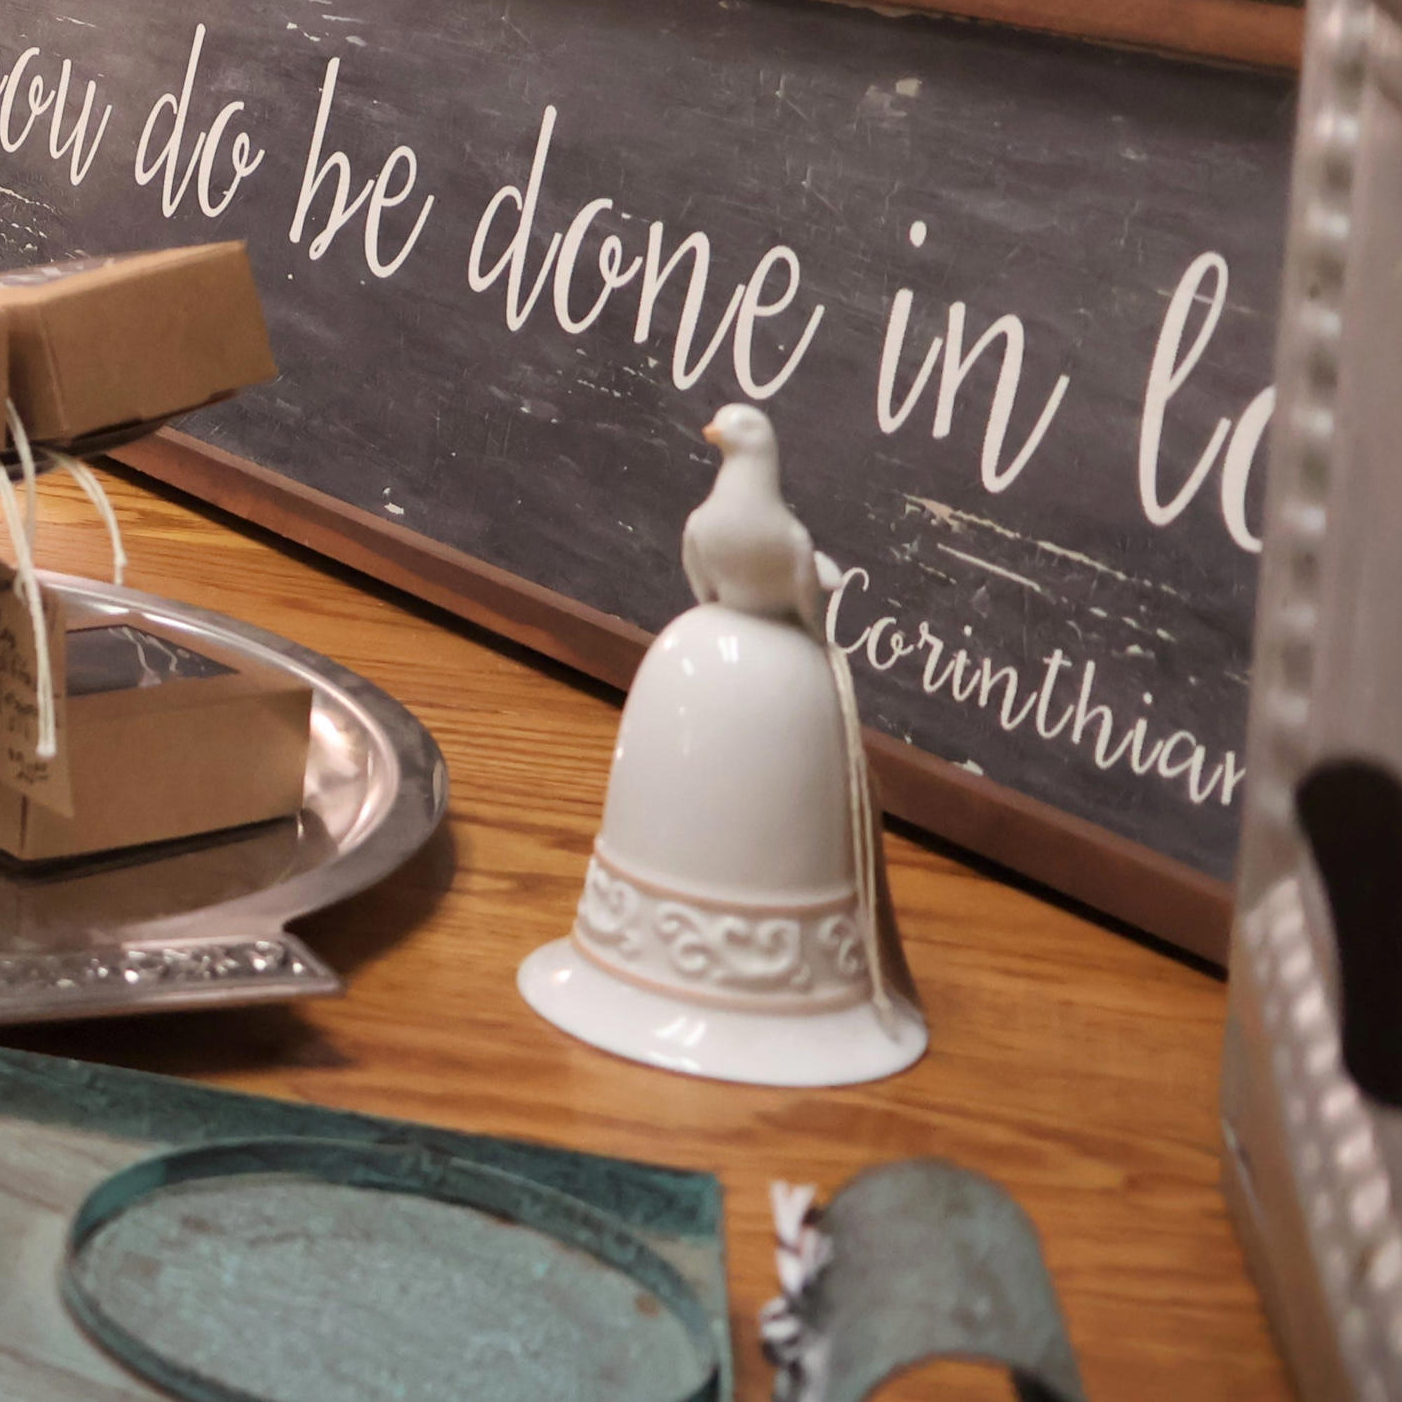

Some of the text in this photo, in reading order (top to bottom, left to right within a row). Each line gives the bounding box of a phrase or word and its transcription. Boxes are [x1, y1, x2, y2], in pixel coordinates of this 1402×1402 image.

[135, 23, 265, 217] do
[289, 57, 434, 278] be
[467, 105, 824, 400] done
[877, 220, 1070, 493] in
